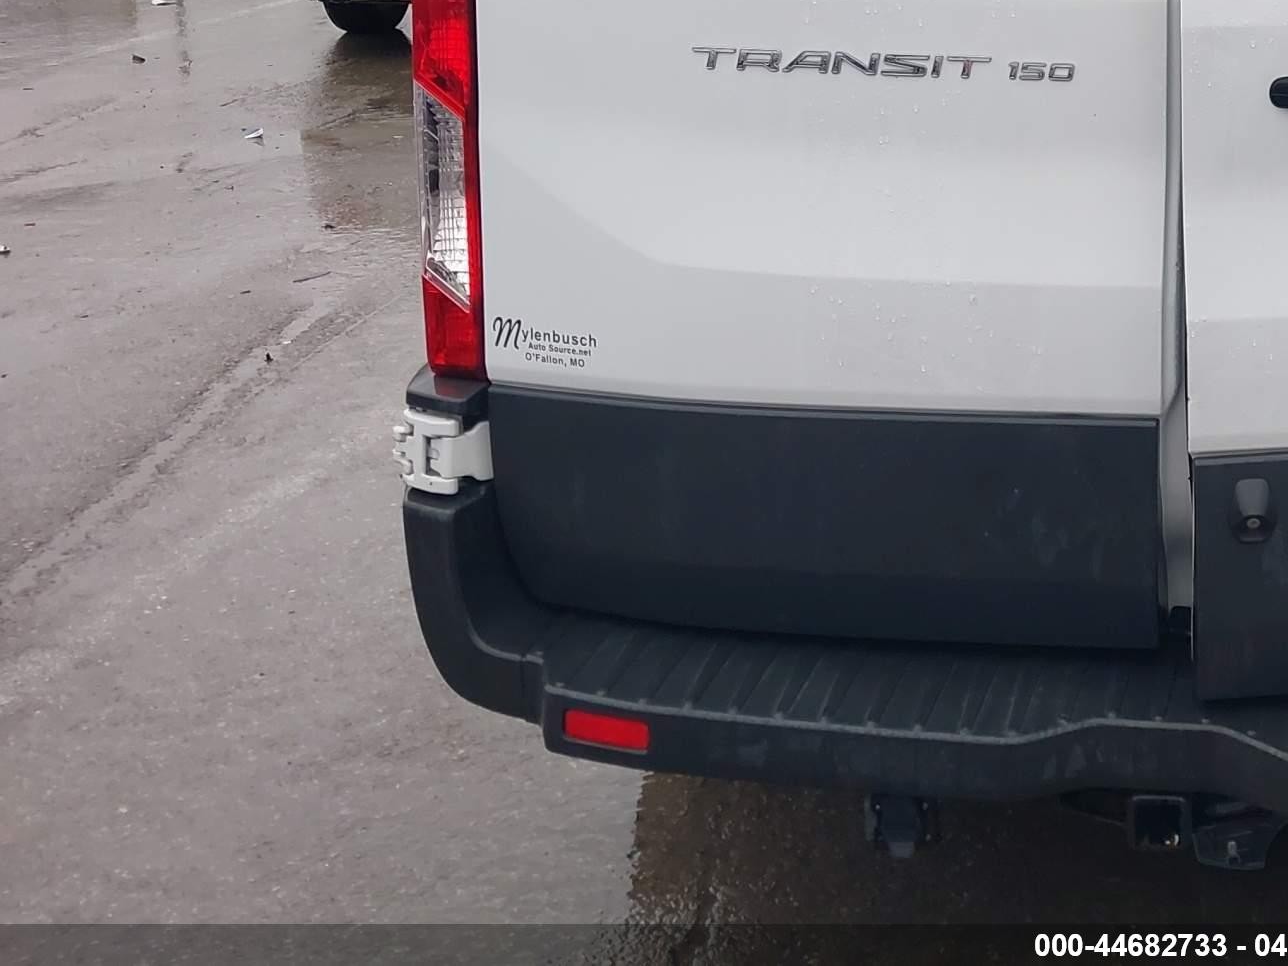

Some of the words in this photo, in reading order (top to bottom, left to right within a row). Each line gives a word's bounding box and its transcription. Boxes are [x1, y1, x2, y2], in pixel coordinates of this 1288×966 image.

[692, 46, 992, 79] TRANSIT
[1007, 61, 1075, 82] 150
[492, 316, 597, 350] Mylenbusch
[528, 342, 546, 350] Auto
[525, 352, 567, 367] O'Fallon,
[570, 358, 585, 368] MO
